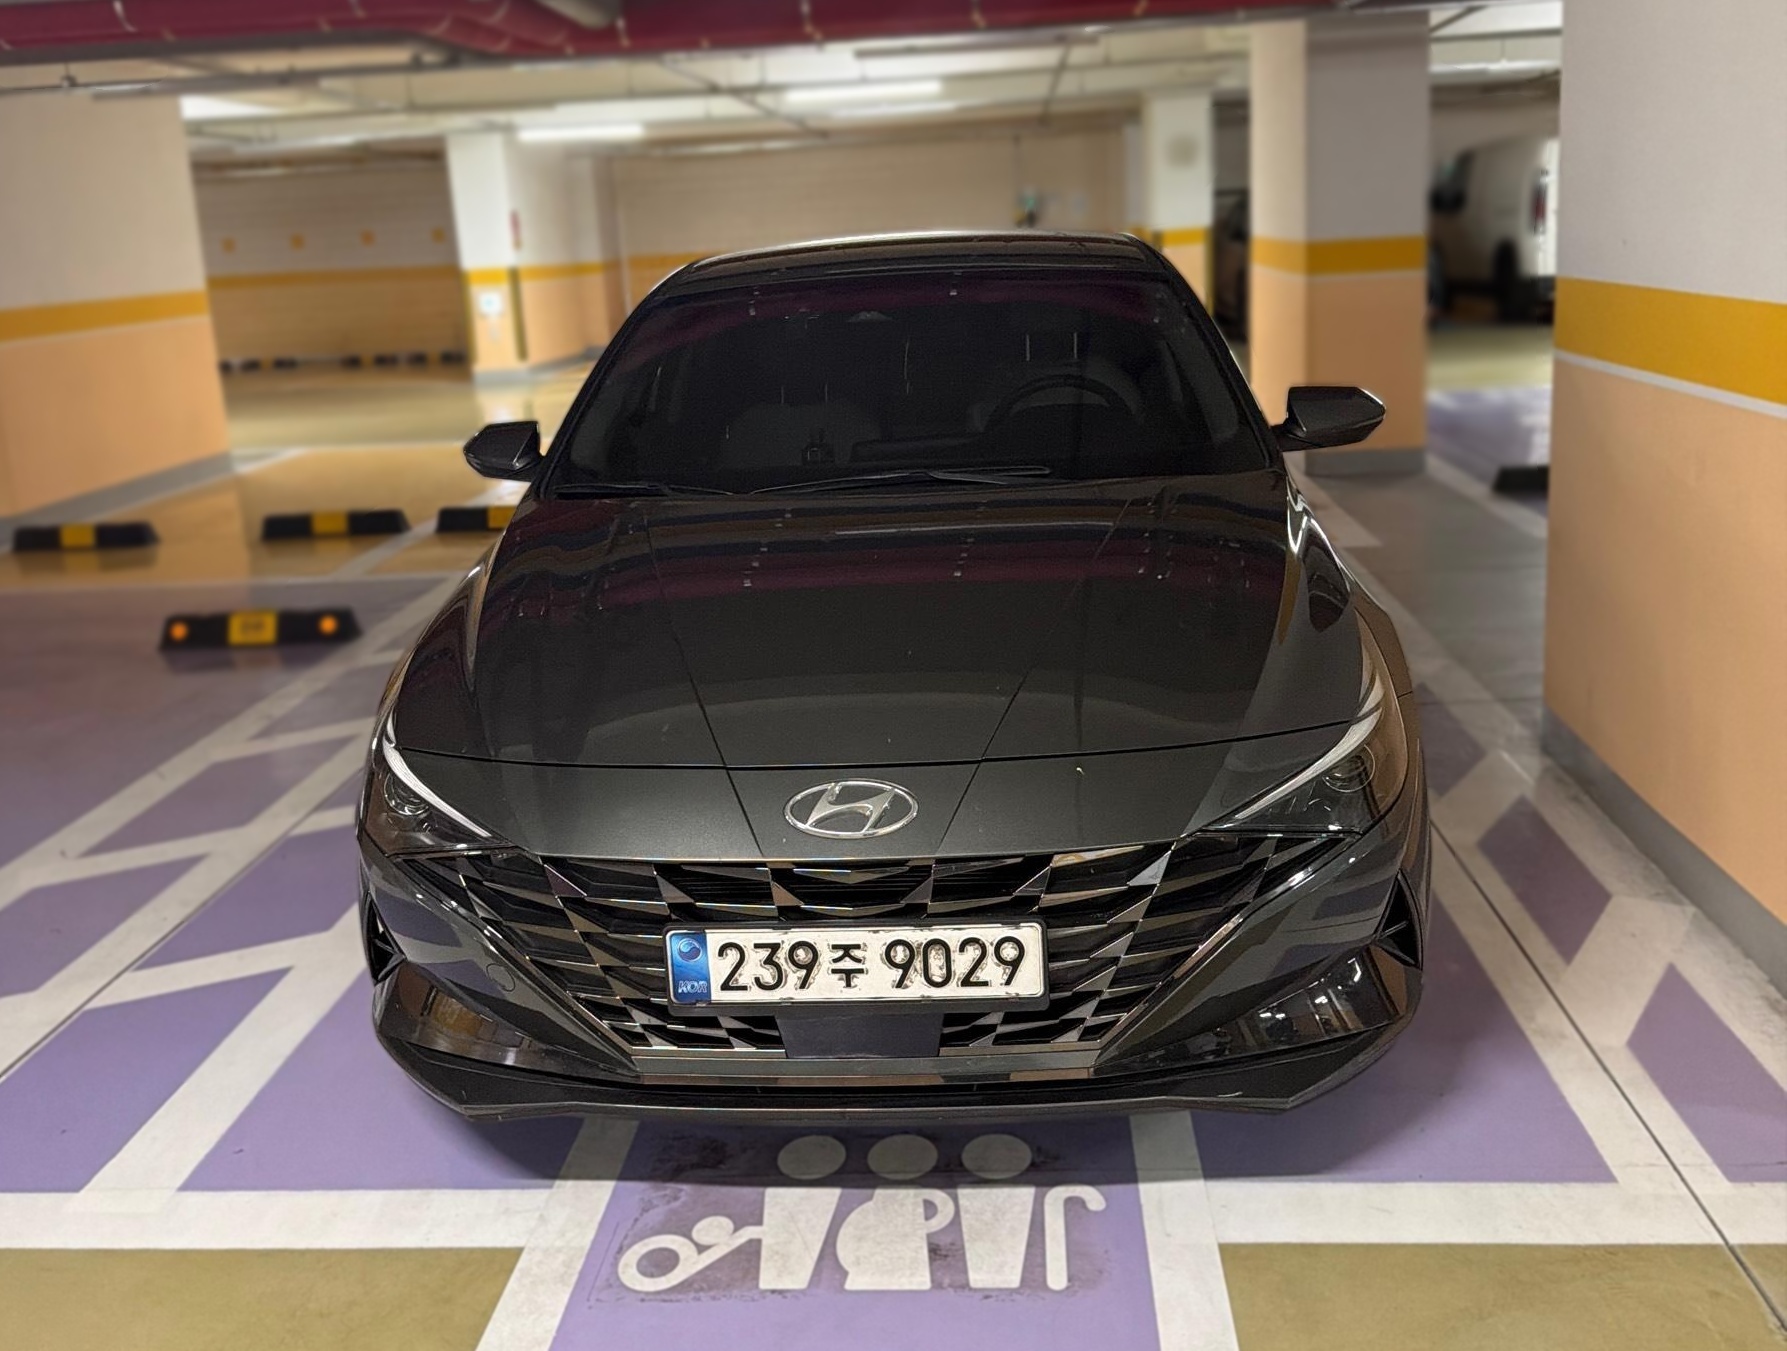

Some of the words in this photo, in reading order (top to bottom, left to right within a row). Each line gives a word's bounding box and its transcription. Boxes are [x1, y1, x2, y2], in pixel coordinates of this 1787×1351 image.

[717, 940, 867, 991] 239주
[884, 935, 1026, 989] 9029
[677, 980, 708, 994] KOR
